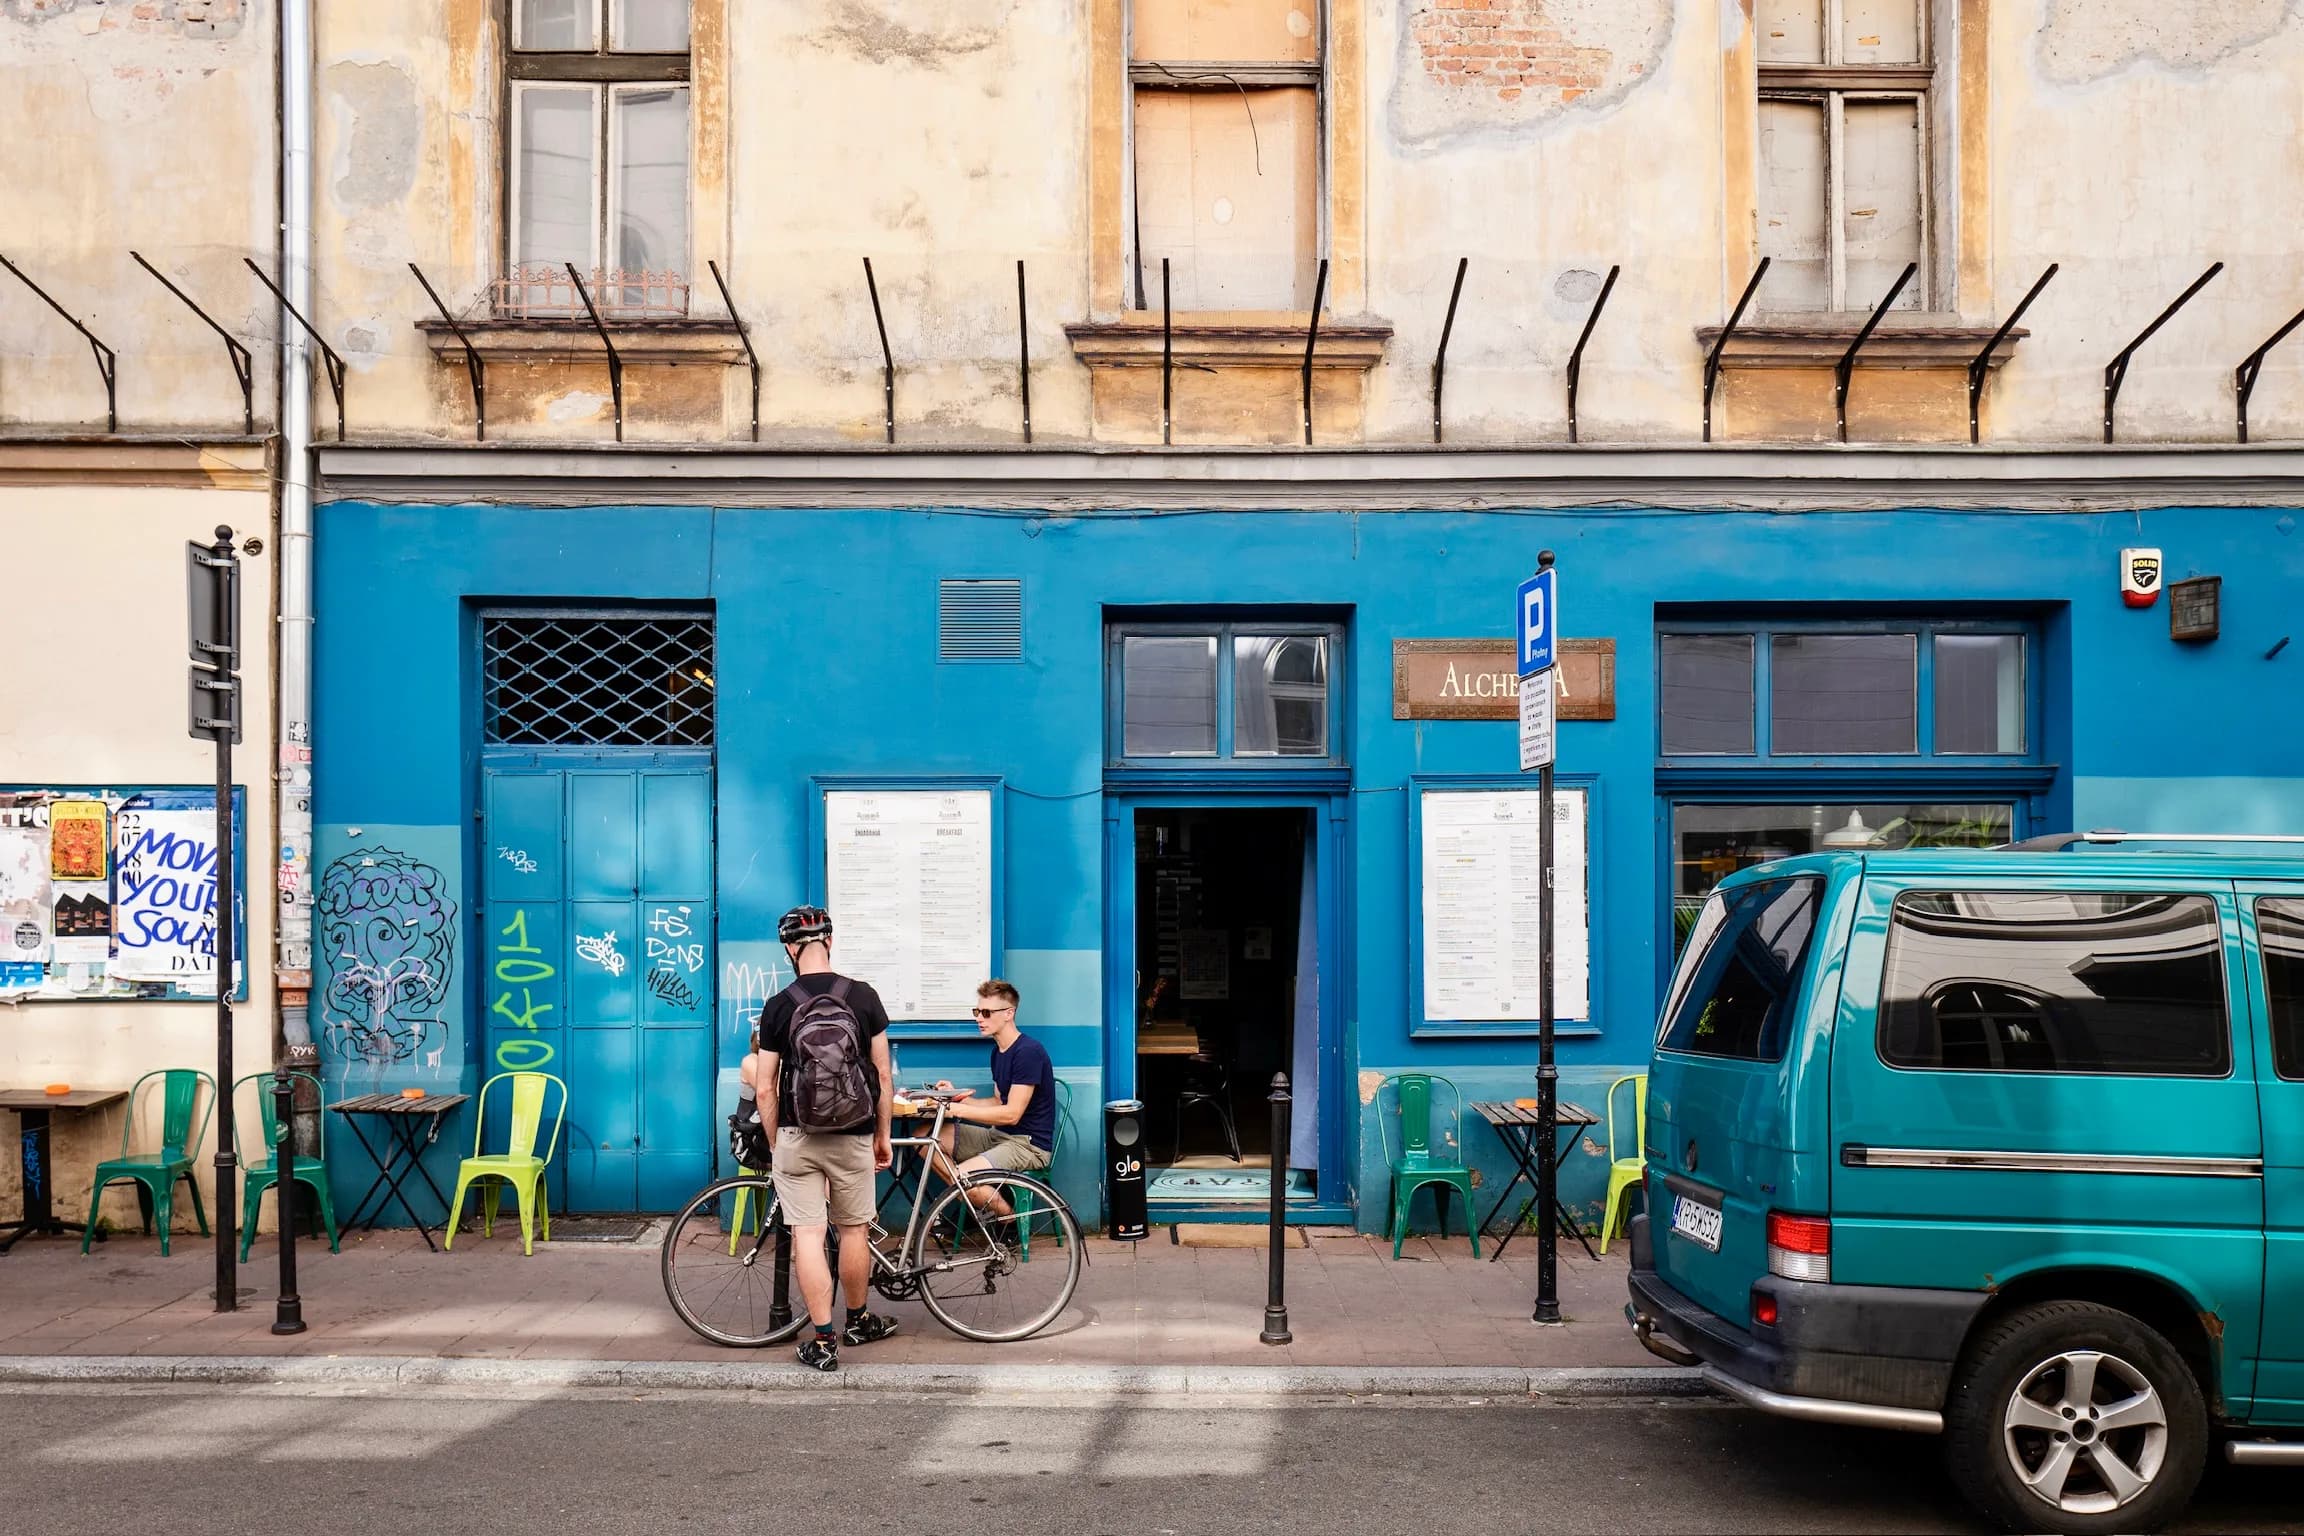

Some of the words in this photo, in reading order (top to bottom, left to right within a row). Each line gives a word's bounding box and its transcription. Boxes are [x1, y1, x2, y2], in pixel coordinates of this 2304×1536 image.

[2133, 560, 2157, 568] SOLID
[1524, 587, 1545, 664] P
[1439, 661, 1570, 698] ALCHEA
[121, 814, 141, 829] 22
[1115, 1154, 1141, 1177] glo
